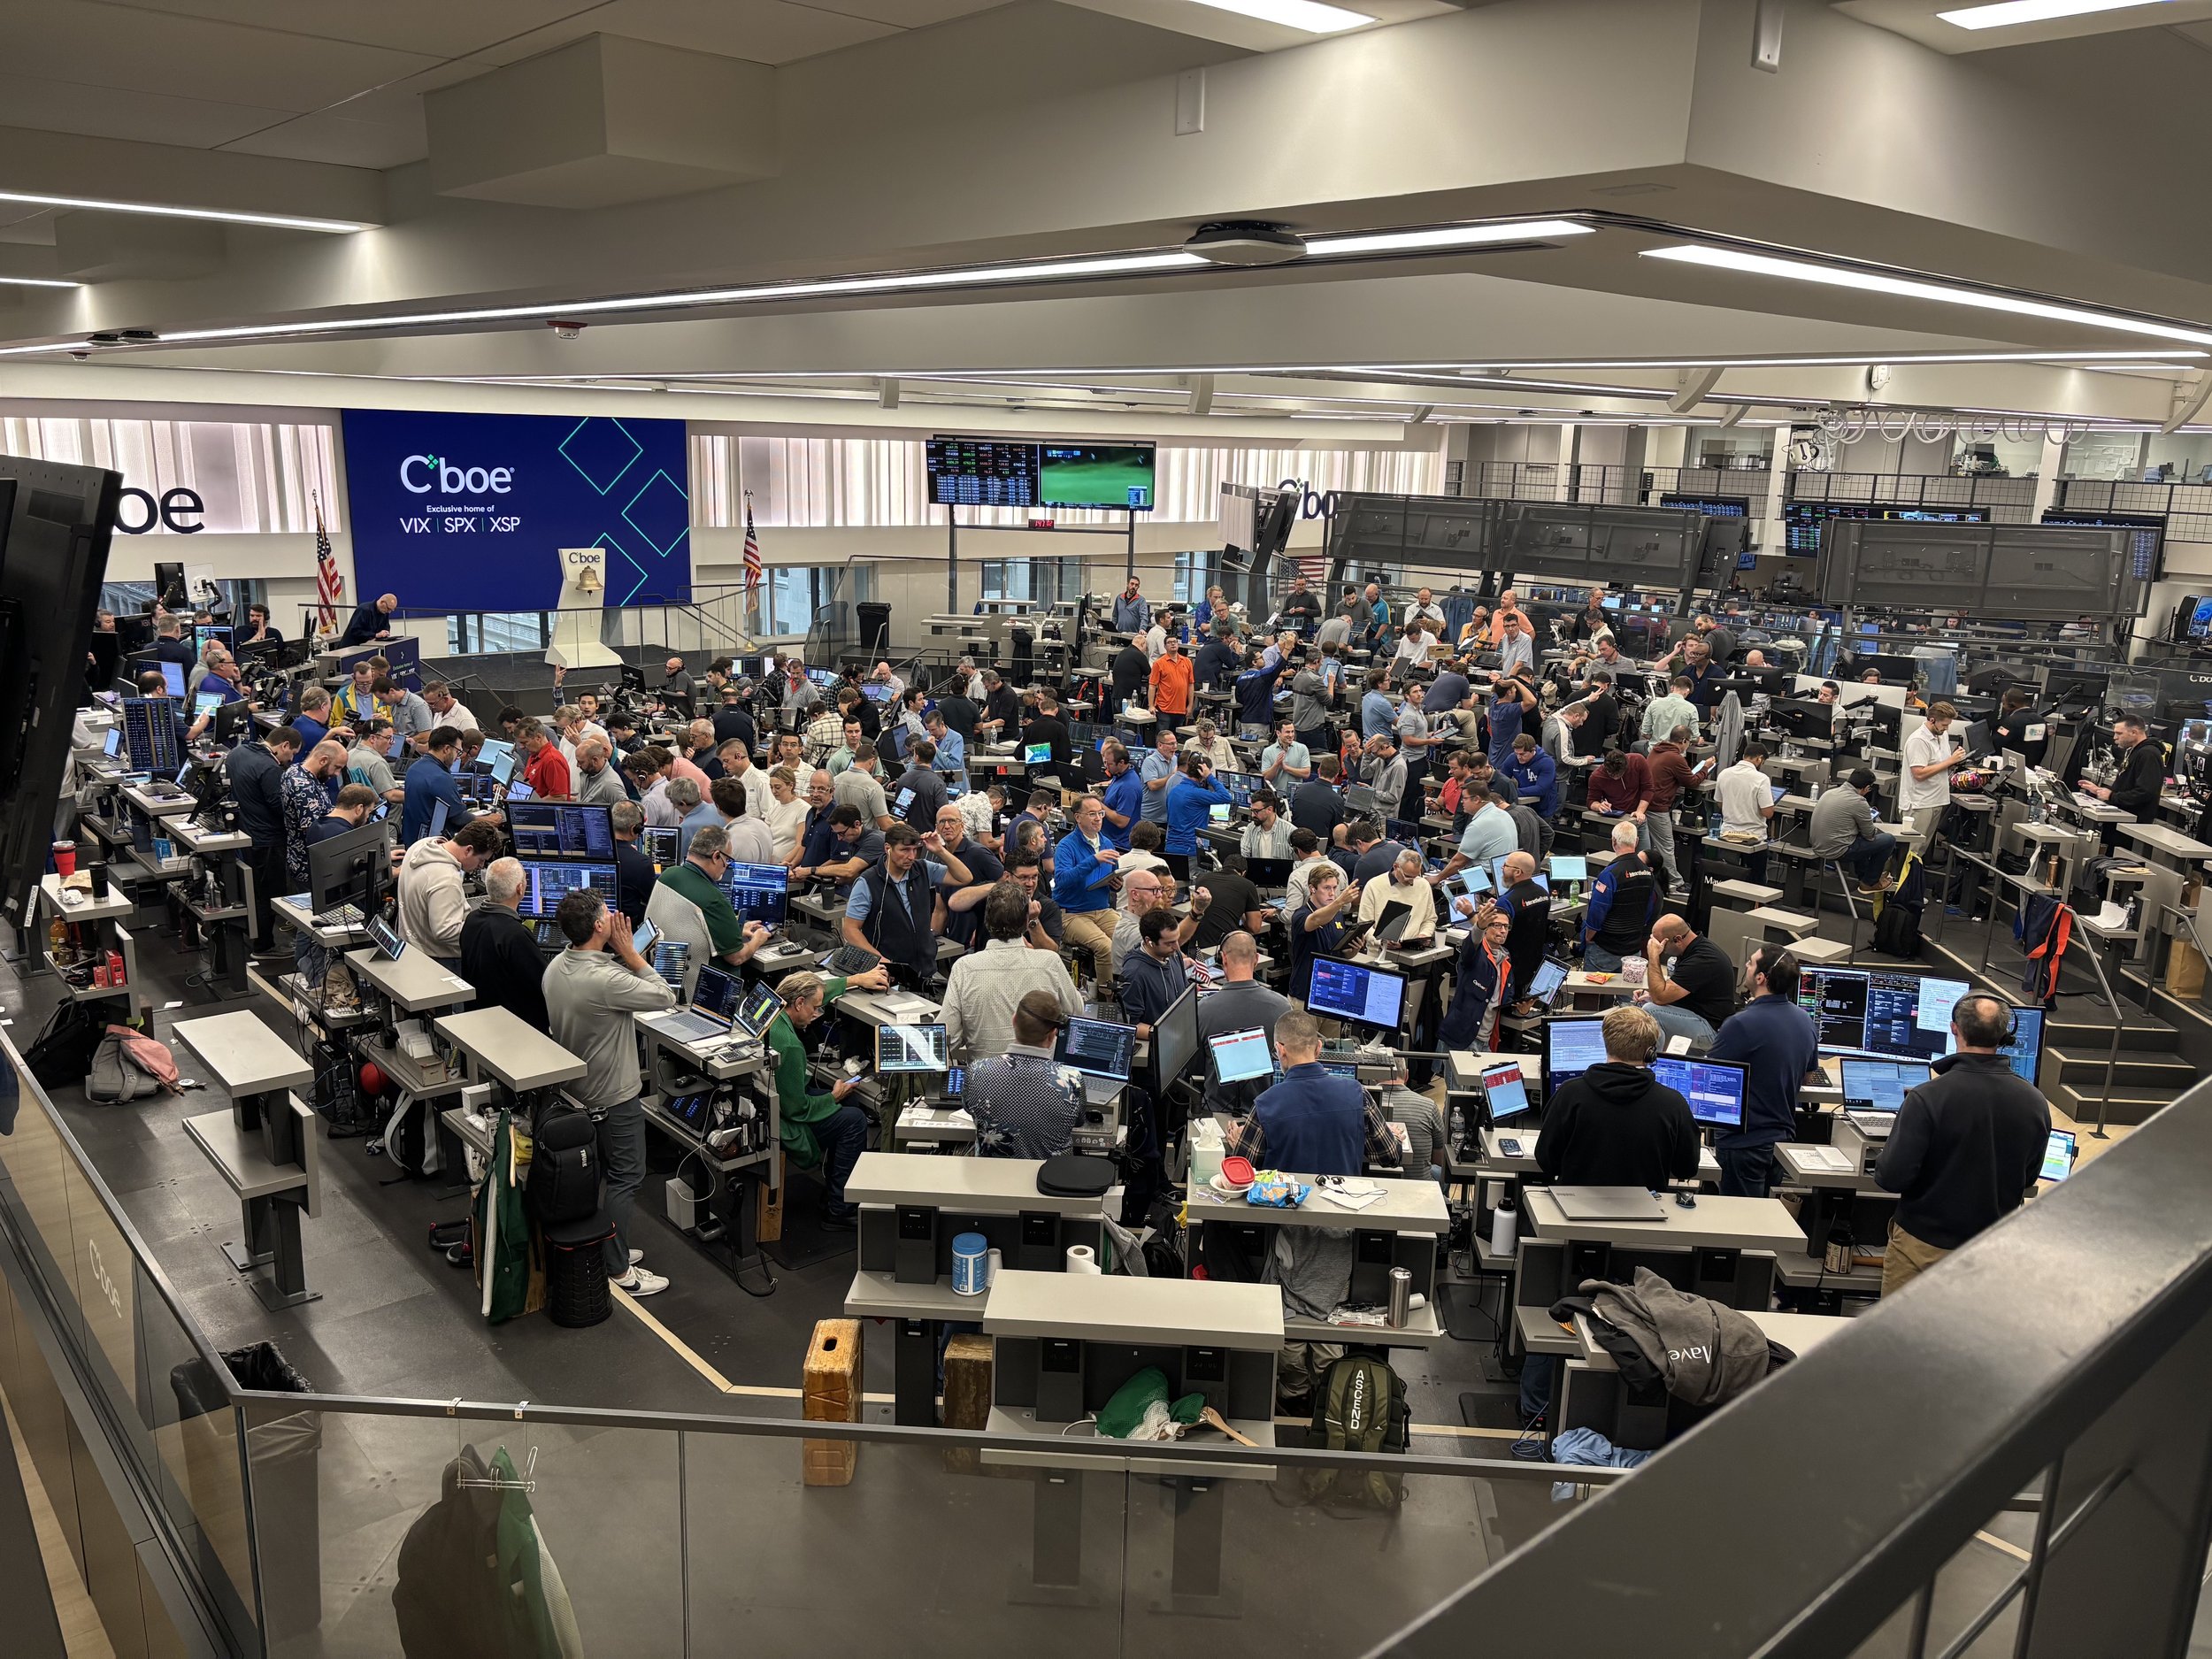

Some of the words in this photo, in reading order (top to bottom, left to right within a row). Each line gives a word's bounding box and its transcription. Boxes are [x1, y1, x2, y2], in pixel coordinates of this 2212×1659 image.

[400, 517, 432, 533] VIX
[444, 517, 477, 533] SPX
[490, 516, 521, 533] XSP
[569, 552, 600, 563] Cboe
[1527, 768, 1538, 782] LA
[1350, 1369, 1365, 1430] ASCEND
